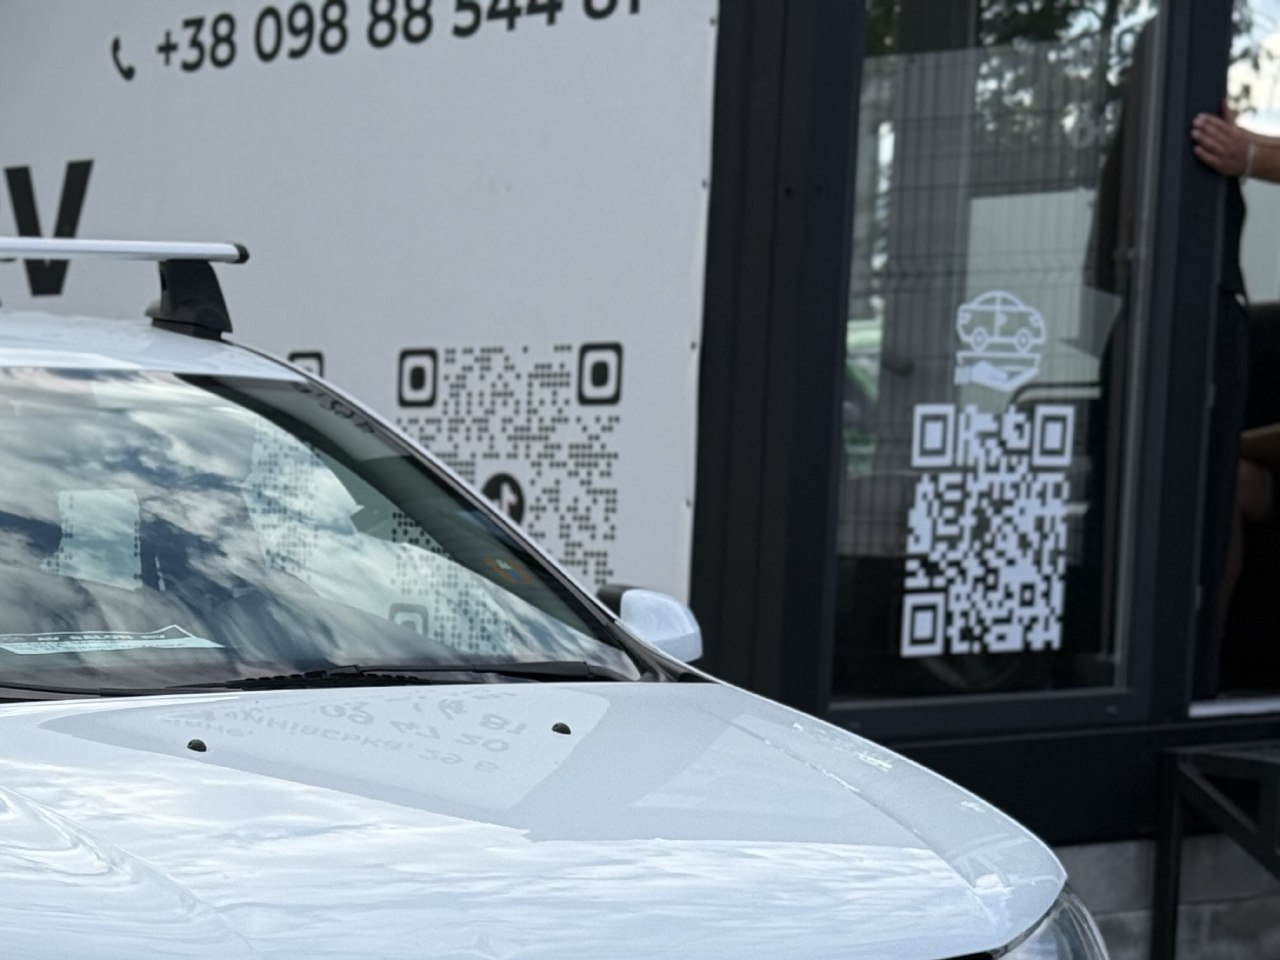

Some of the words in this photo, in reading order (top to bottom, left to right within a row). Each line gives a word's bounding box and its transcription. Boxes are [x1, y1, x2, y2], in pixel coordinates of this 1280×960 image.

[156, 13, 237, 72] +38
[254, 0, 348, 62] 098
[366, 0, 433, 48] 88
